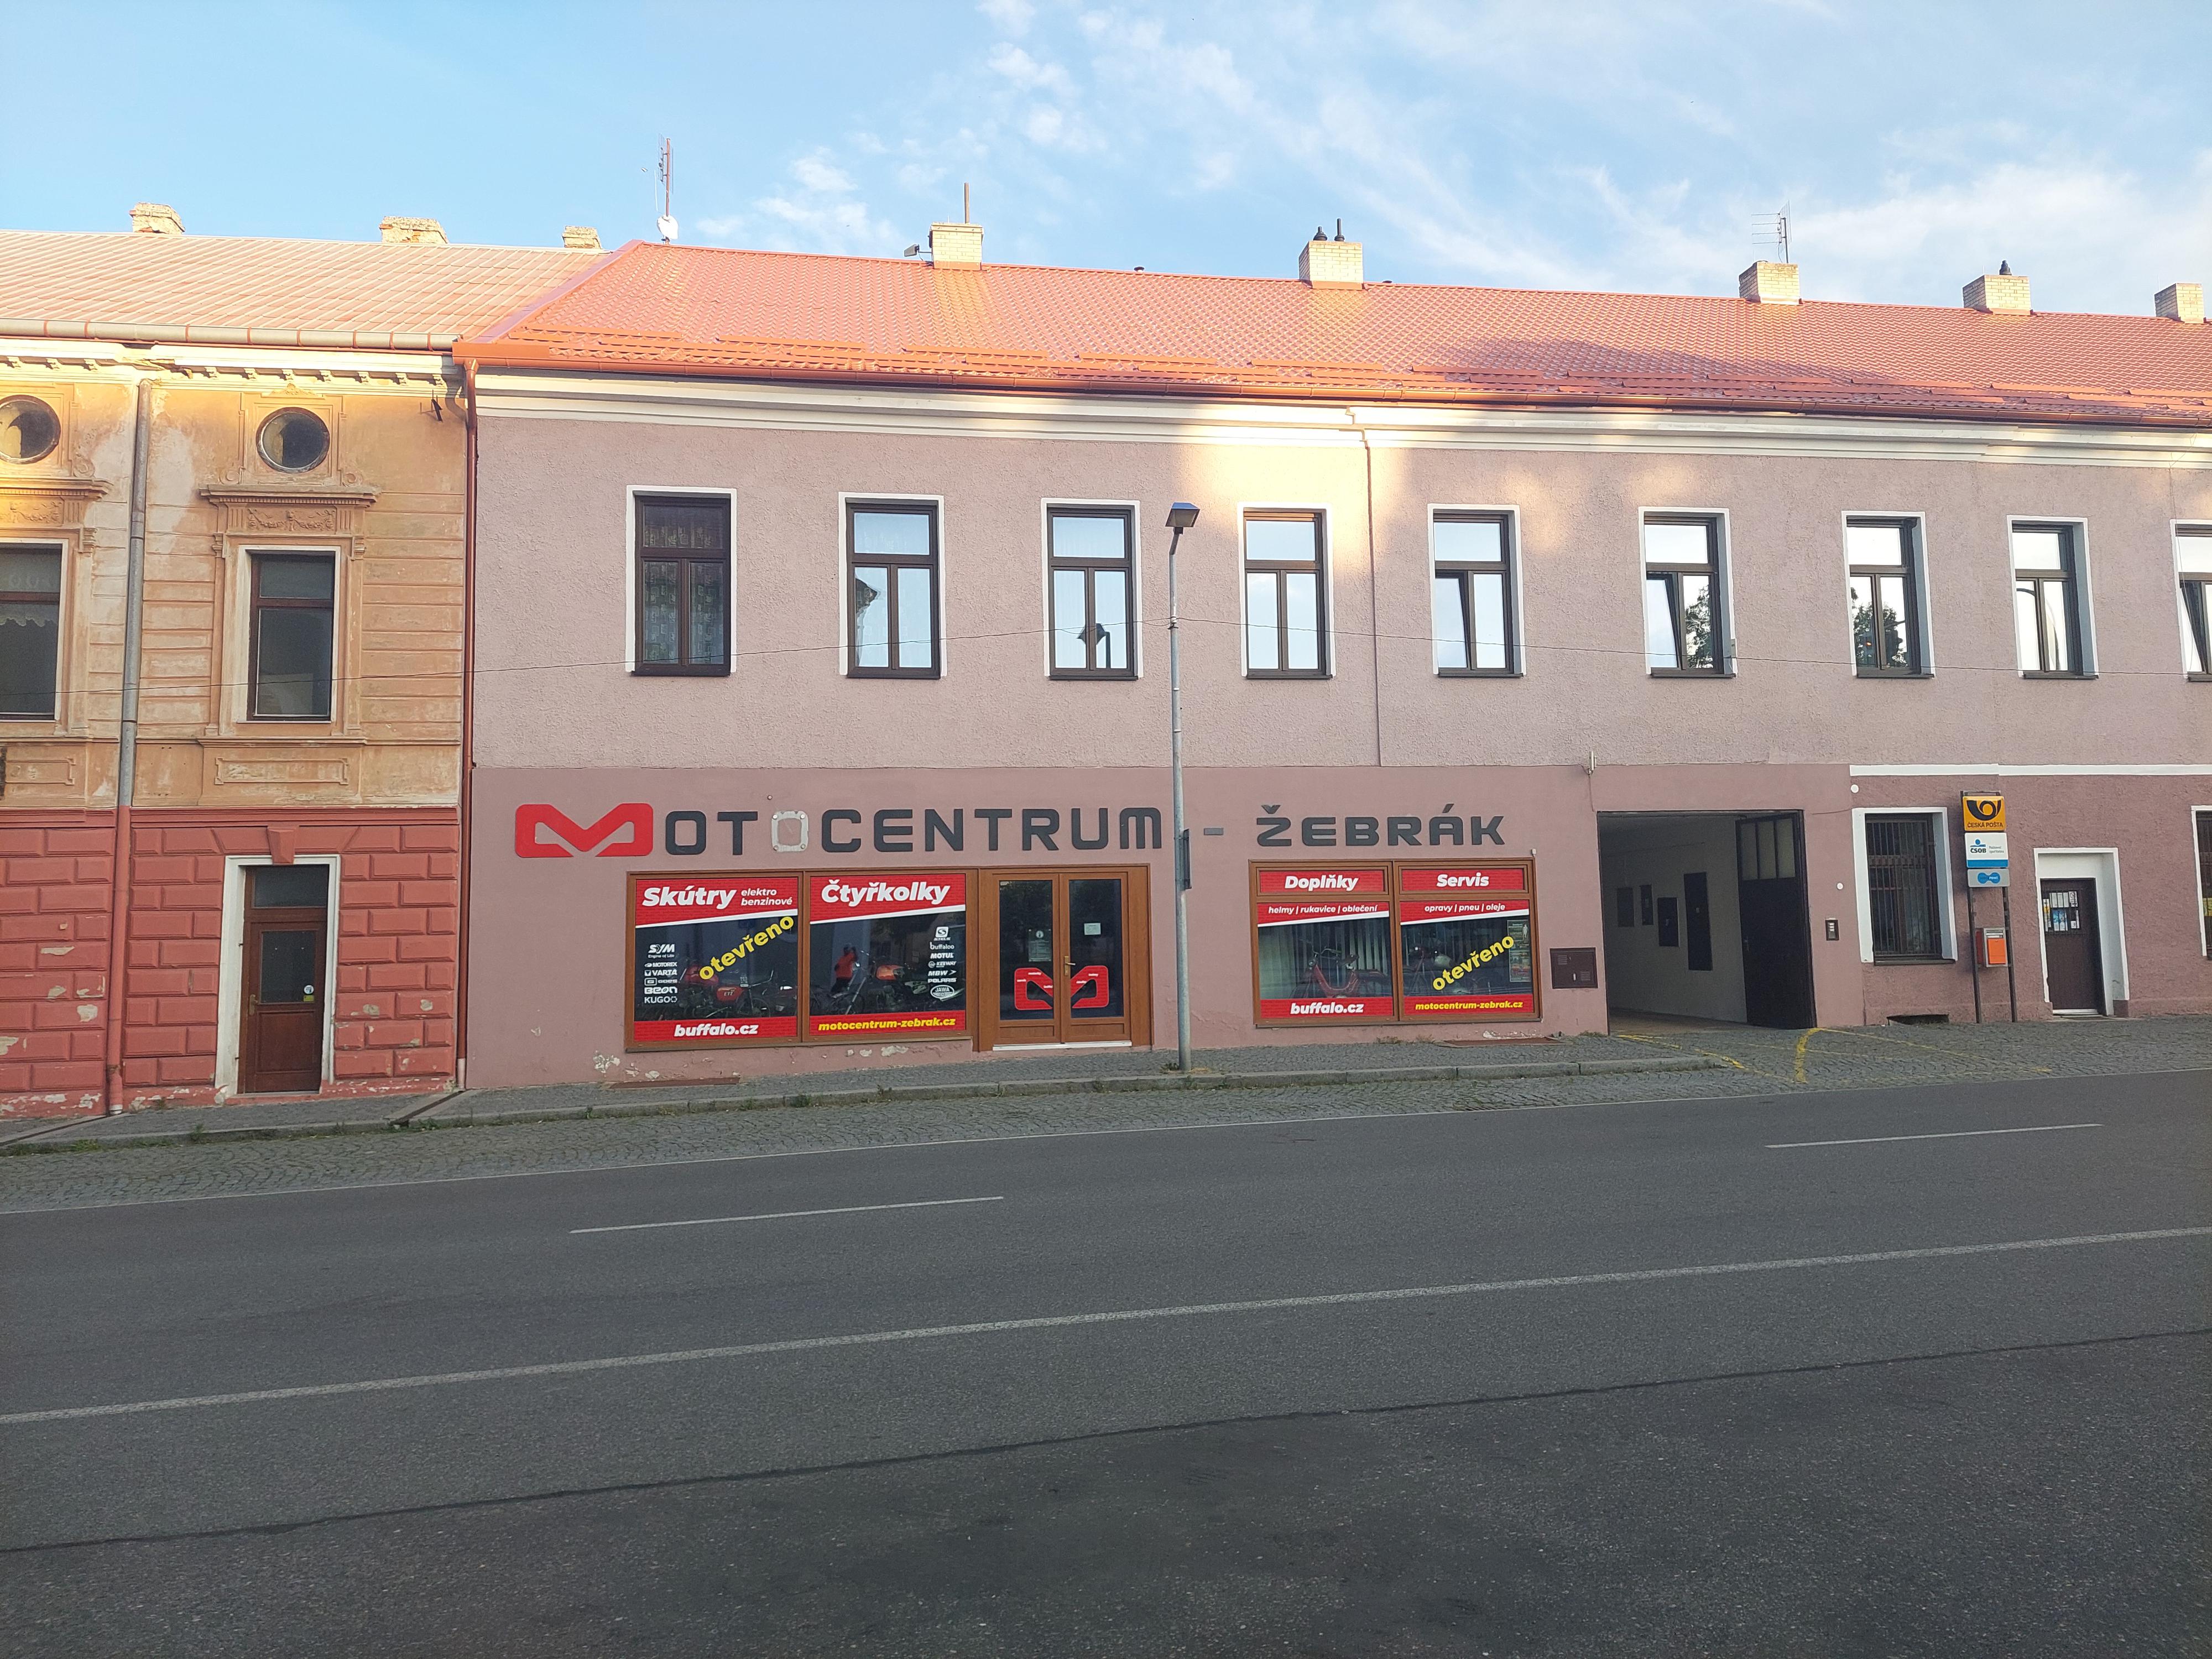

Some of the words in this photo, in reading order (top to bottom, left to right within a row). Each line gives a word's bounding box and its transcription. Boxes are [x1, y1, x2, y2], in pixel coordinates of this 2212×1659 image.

[1256, 804, 1505, 847] ŽEBRÁK
[1285, 874, 1359, 891] Doplňky
[1436, 872, 1489, 887] Servis
[642, 885, 737, 909] Skútry
[741, 888, 777, 896] elektro
[821, 879, 951, 907] Čtyřkolky
[741, 896, 792, 906] benzinové
[1425, 904, 1453, 912] opravy
[1486, 903, 1505, 912] oleje
[1269, 906, 1295, 915] helmy
[1300, 905, 1335, 914] rukavice
[648, 943, 675, 954] SYM
[700, 916, 794, 979] otevřeno
[1433, 936, 1514, 990] otevřeno
[1290, 1001, 1364, 1015] buffalo.cz
[1415, 1000, 1523, 1010] motocentrum-zebrak.cz
[674, 1022, 759, 1037] buffalo.cz
[818, 1018, 956, 1031] motocentrum-zebrak.cz
